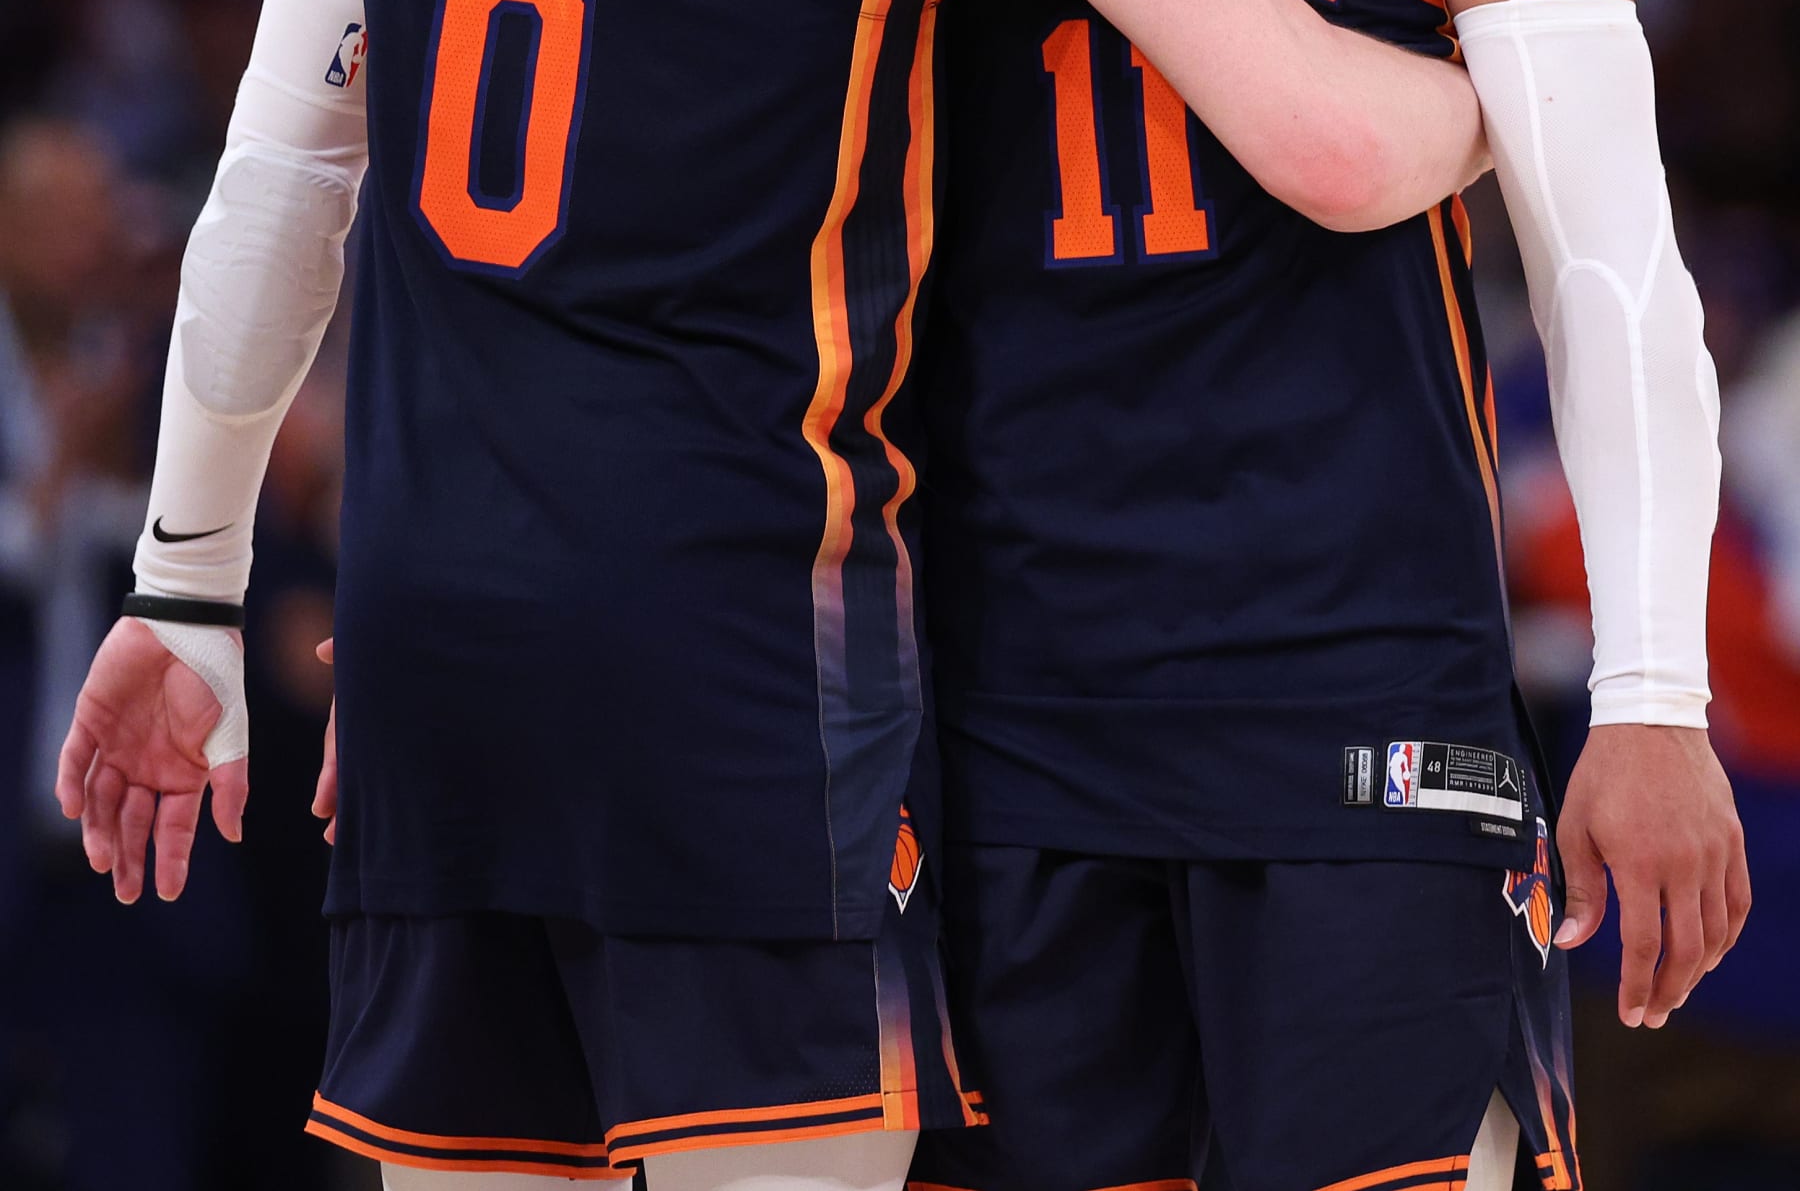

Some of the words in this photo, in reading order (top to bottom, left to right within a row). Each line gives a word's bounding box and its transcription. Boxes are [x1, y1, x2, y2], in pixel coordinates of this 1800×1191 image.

[1040, 18, 1210, 261] 11
[1450, 748, 1494, 762] ENGINEERED
[1426, 760, 1441, 774] 48
[1388, 791, 1401, 803] NBA
